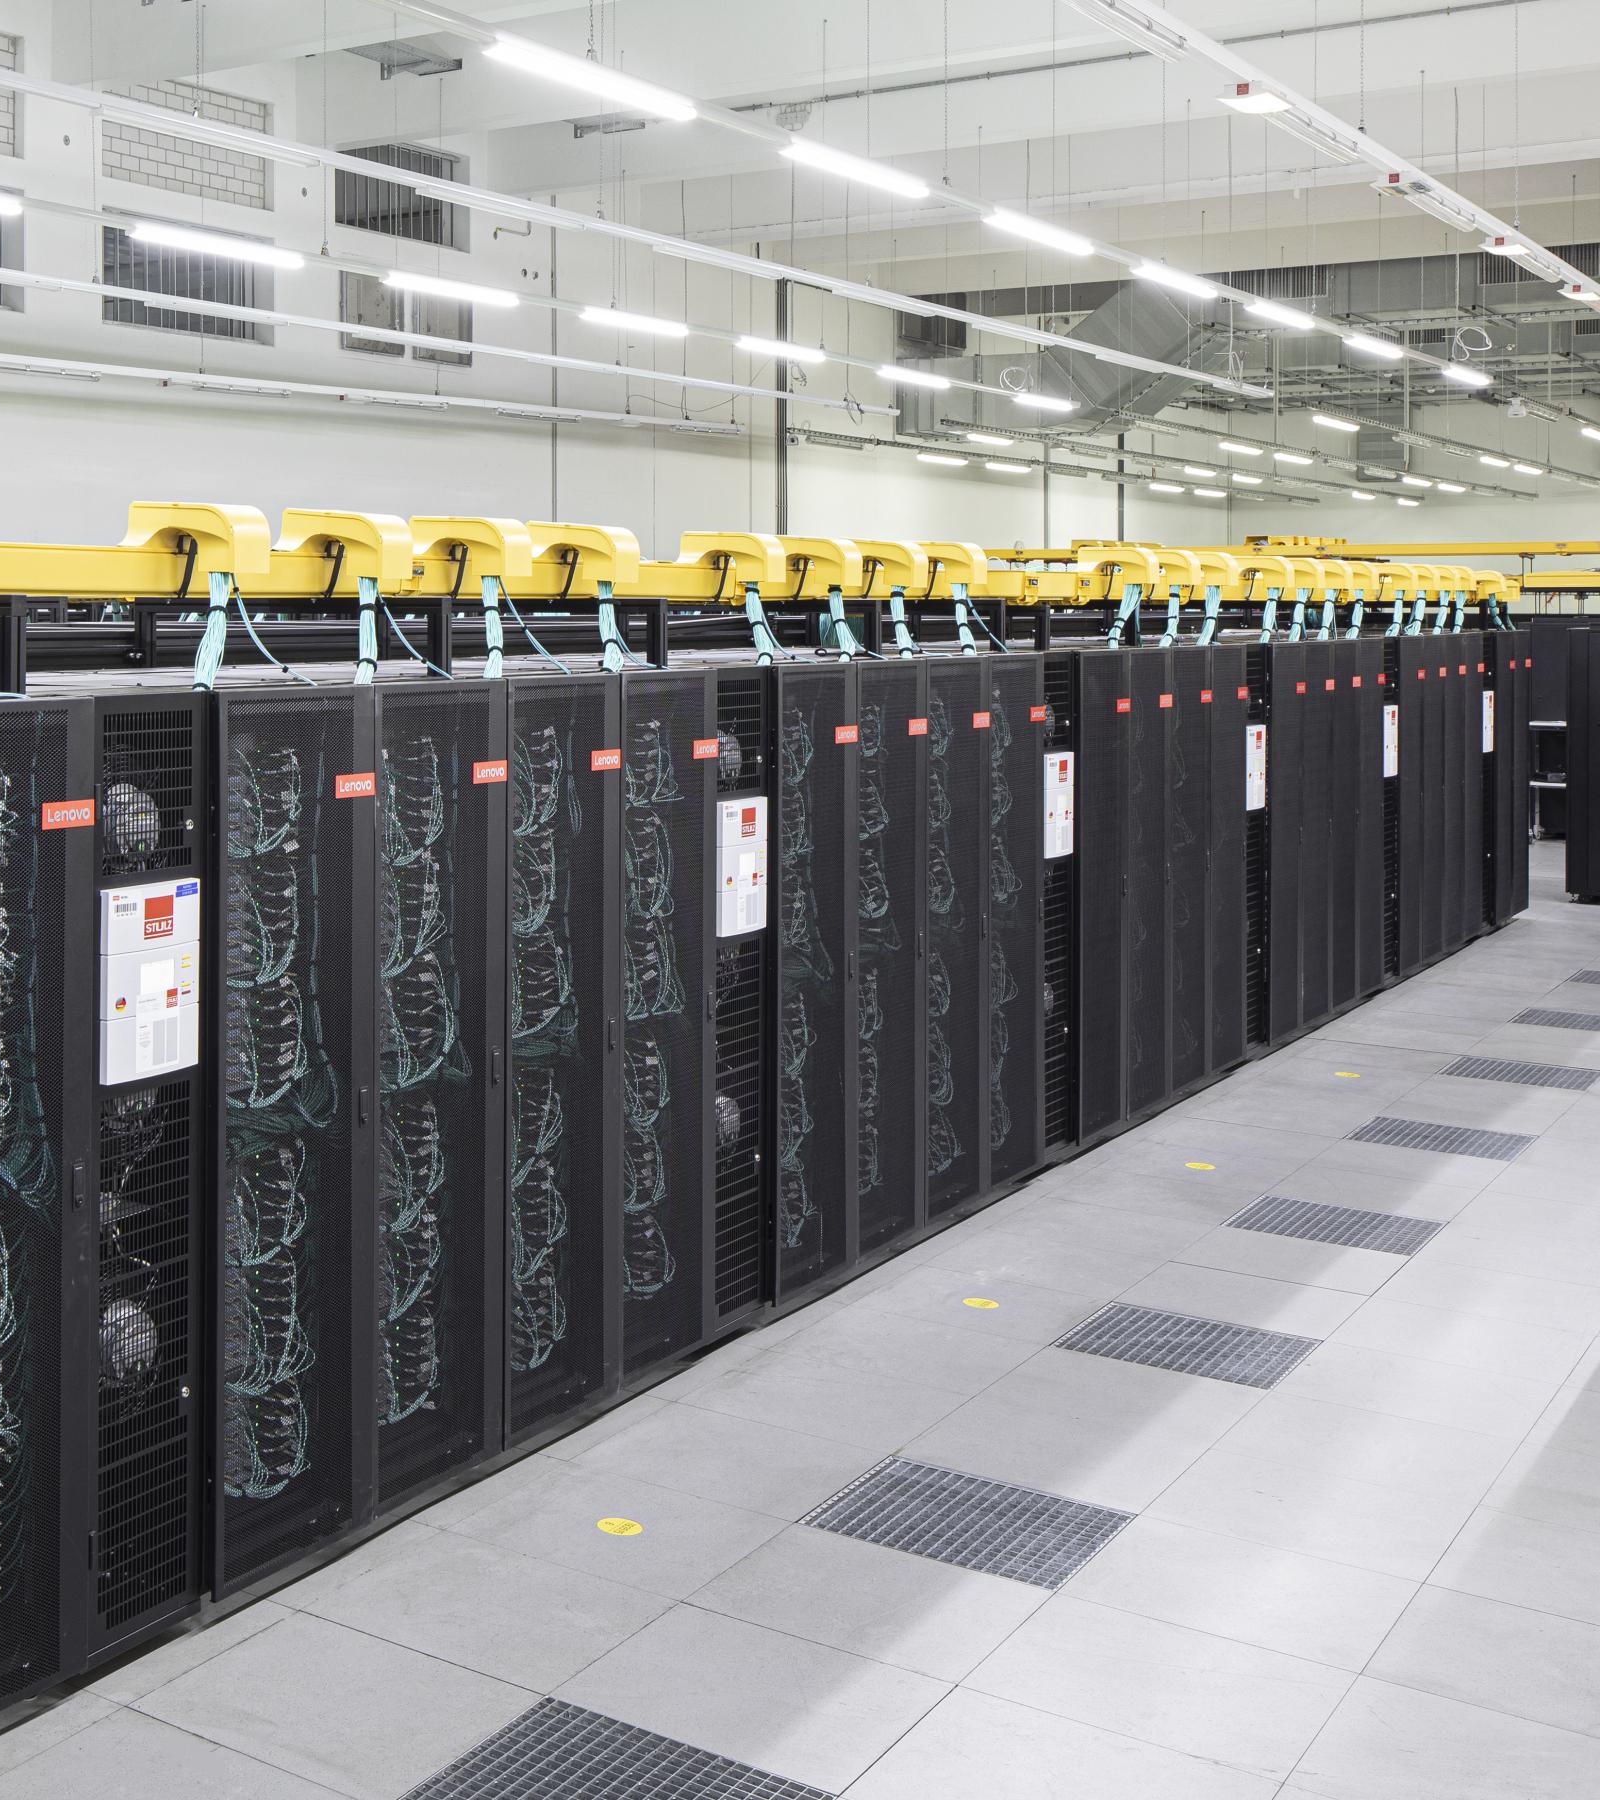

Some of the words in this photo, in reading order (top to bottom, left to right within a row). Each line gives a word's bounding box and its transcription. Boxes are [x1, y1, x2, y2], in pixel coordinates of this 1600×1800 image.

[595, 755, 619, 766] Lenovo
[477, 767, 505, 779] Lenovo
[339, 780, 372, 793] Lenovo
[47, 808, 91, 823] Lenovo
[145, 920, 173, 934] STULZ
